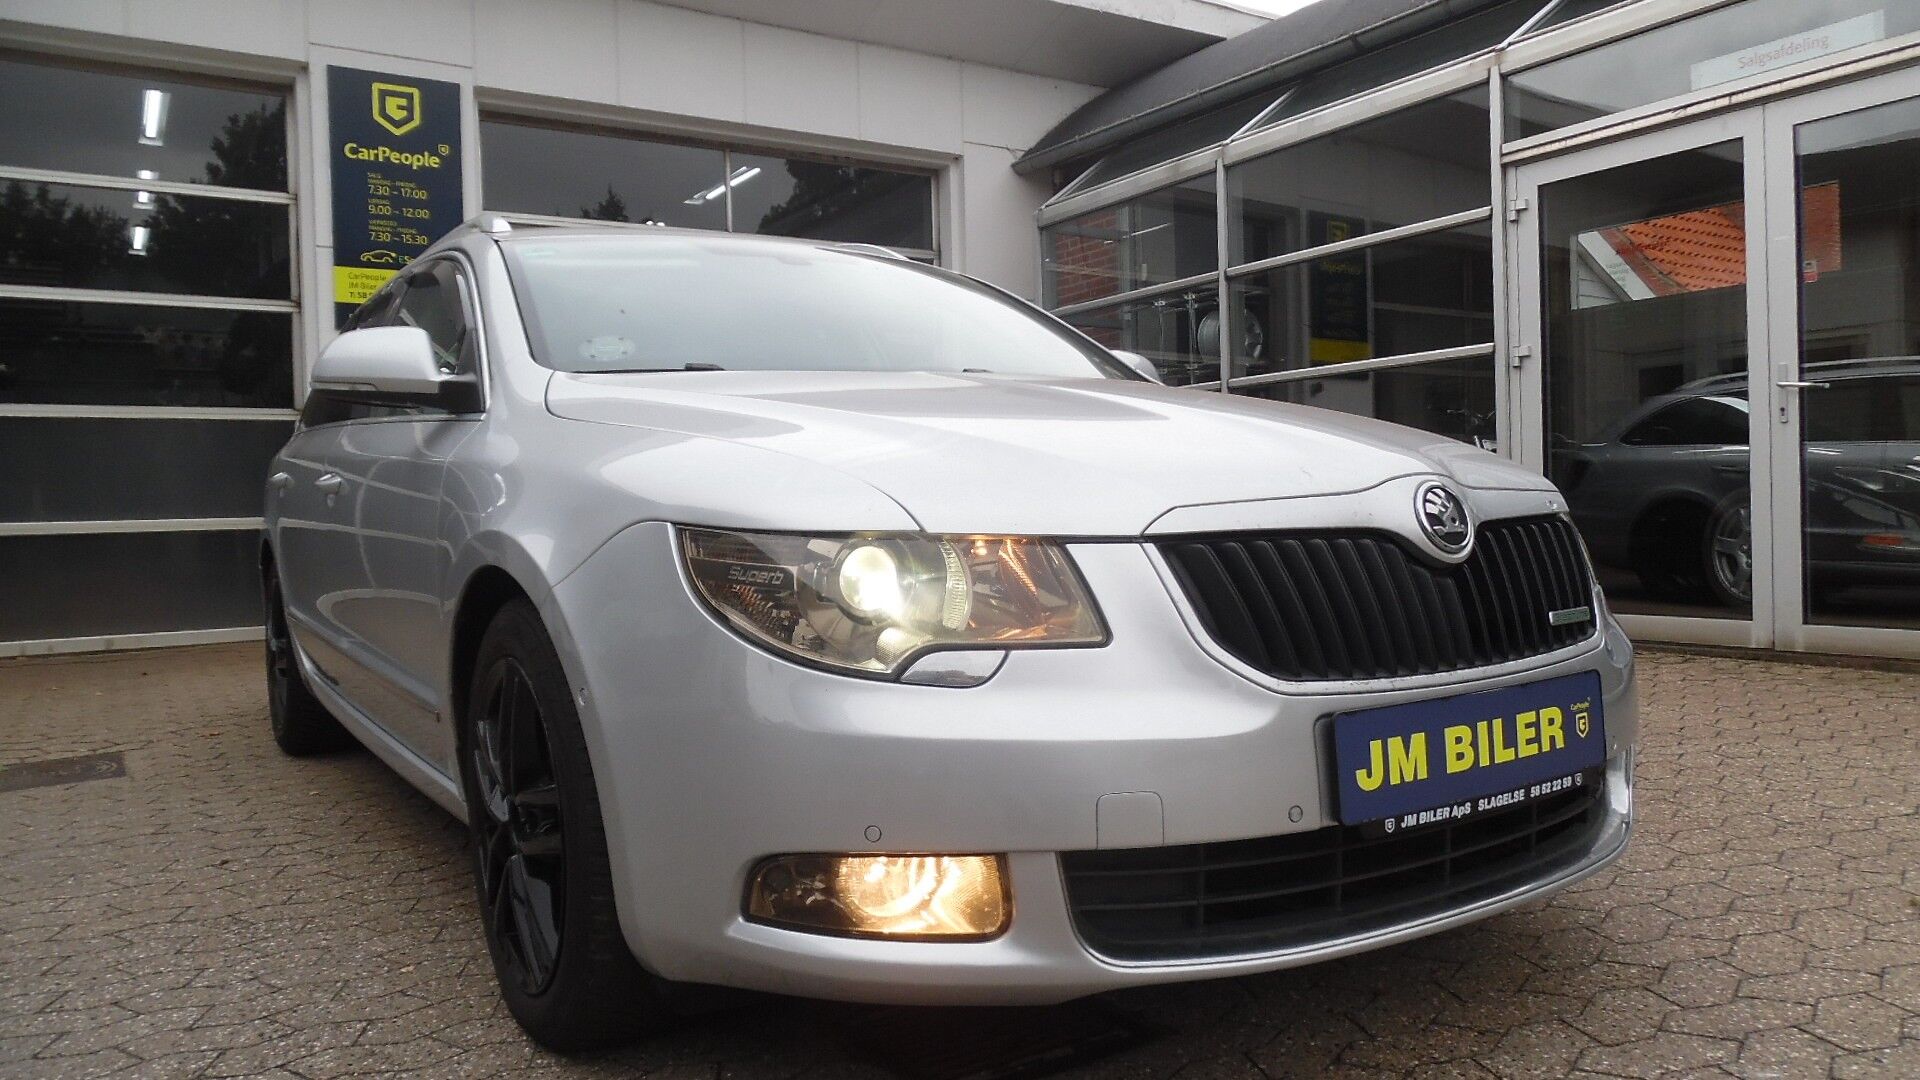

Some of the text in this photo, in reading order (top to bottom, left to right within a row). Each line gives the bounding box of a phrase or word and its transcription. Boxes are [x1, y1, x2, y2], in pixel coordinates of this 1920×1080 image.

[1738, 36, 1829, 69] Salgsafdeling
[343, 142, 441, 170] CarPeople
[367, 184, 390, 196] 7.30
[401, 187, 427, 200] 17.00
[368, 204, 392, 216] 9.00
[402, 207, 430, 219] 12.00
[368, 231, 391, 243] 7.30
[401, 234, 428, 246] 15.30
[728, 566, 784, 584] Superb
[1355, 706, 1564, 792] JM BILER
[1401, 815, 1418, 829] JM
[1418, 805, 1450, 825] BILER
[1450, 802, 1472, 819] ApS
[1477, 789, 1526, 812] SLAGELSE
[1530, 786, 1541, 798] 58
[1551, 779, 1562, 791] 22
